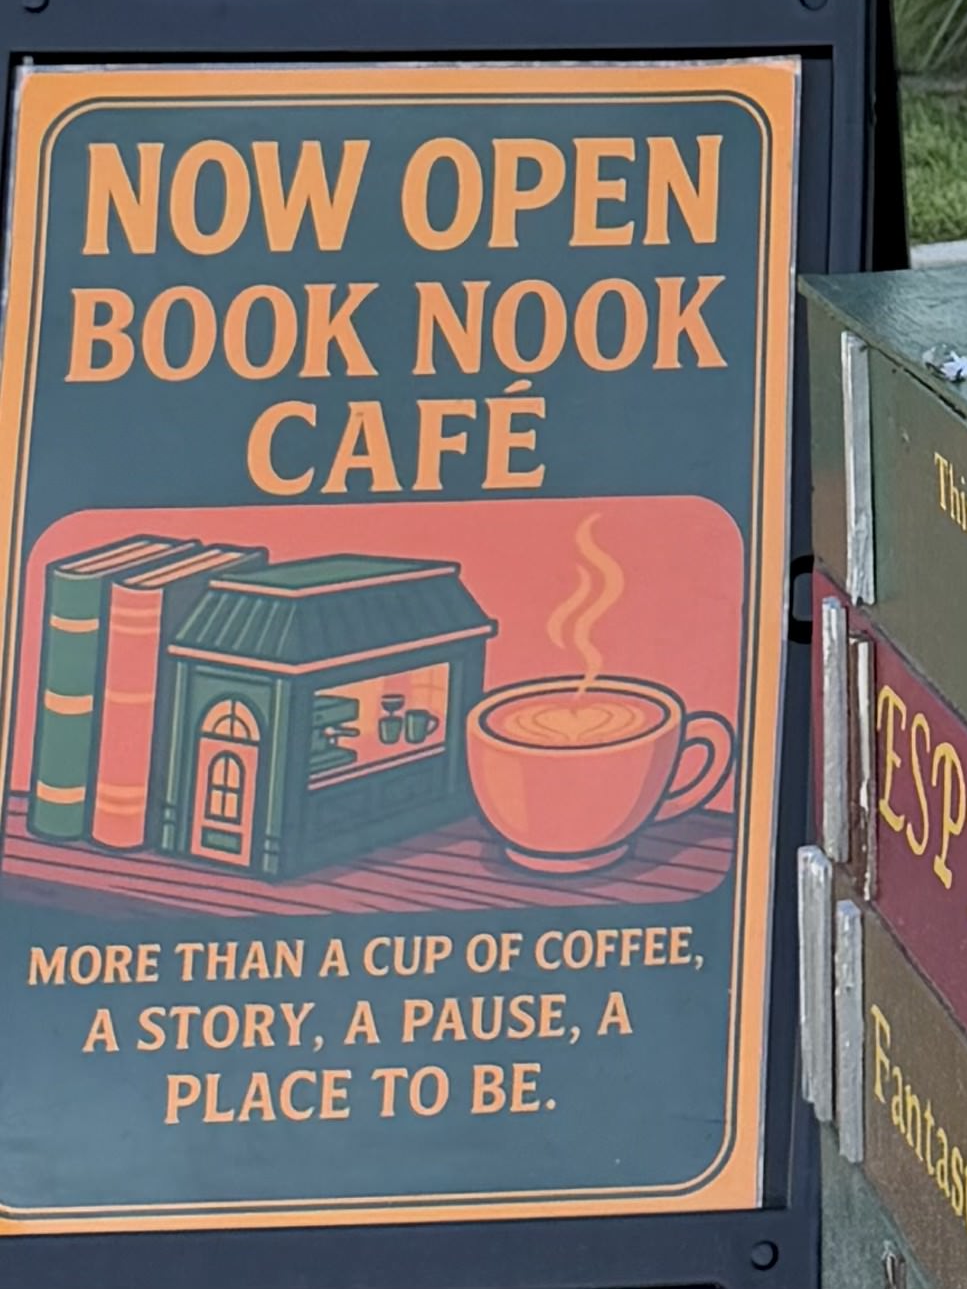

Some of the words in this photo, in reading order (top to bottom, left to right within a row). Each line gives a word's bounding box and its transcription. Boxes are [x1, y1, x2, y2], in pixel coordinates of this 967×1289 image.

[82, 140, 370, 255] NOW
[401, 134, 724, 251] OPEN
[65, 282, 379, 382] BOOK
[412, 275, 729, 375] NOOK
[247, 380, 546, 495] CAFÉ
[28, 944, 160, 985] MORE
[175, 939, 304, 981] THAN
[319, 938, 349, 978] A
[363, 935, 453, 977] CUP
[466, 932, 522, 974] OF
[534, 926, 705, 972] COFFEE,
[82, 1008, 119, 1053] A
[136, 1002, 325, 1052] STORY,
[344, 999, 380, 1046] A
[401, 993, 581, 1044] PAUSE,
[597, 991, 634, 1036] A
[164, 1068, 352, 1125] PLACE
[371, 1066, 450, 1117] TO
[470, 1062, 557, 1115] BE.
